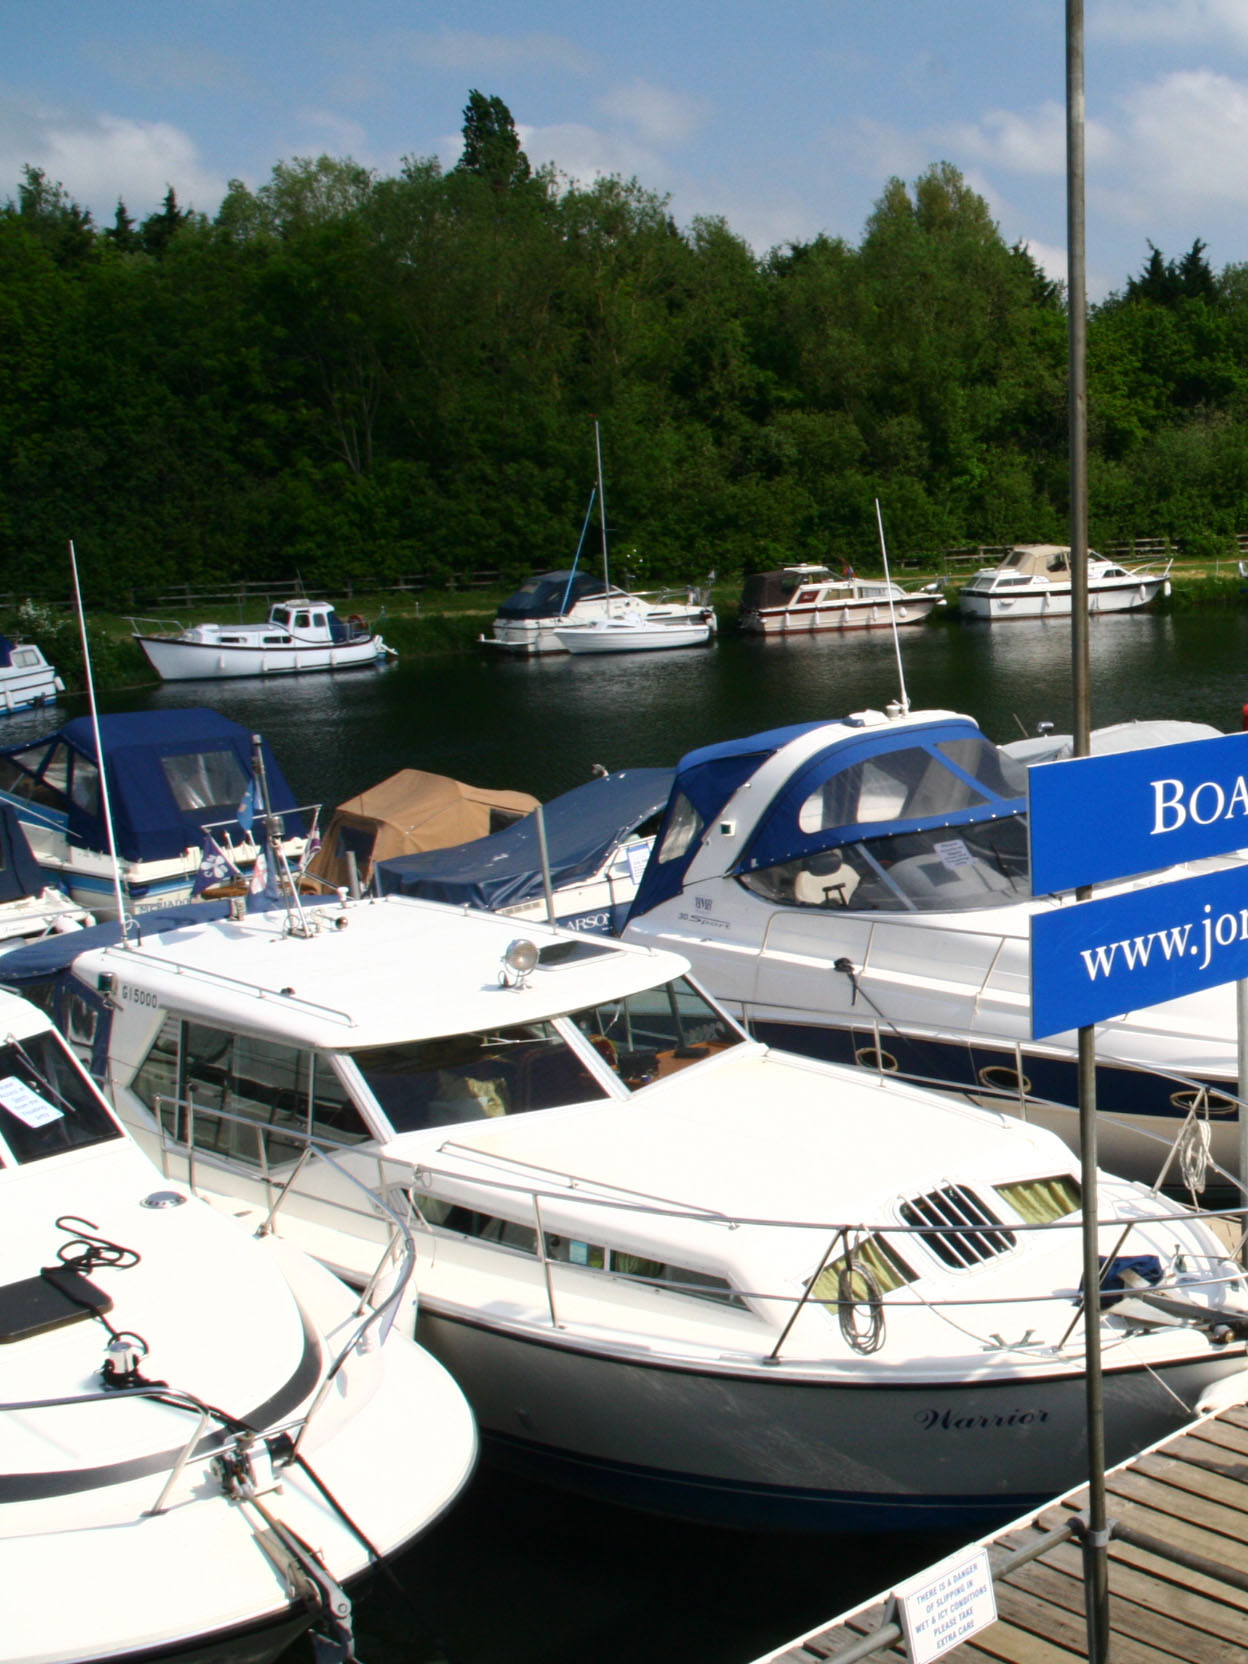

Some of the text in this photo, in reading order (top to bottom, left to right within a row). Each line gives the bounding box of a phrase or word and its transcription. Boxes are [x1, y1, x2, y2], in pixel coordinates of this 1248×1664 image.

[913, 1408, 1049, 1431] Warrior
[916, 1563, 978, 1605] THERE IS A DANGER
[926, 1579, 973, 1613] OF SLIPPING IN
[915, 1620, 930, 1634] WET
[938, 1609, 949, 1621] ICY
[950, 1584, 988, 1613] CONDITIONS
[933, 1606, 974, 1637] PLEASE TAKE
[937, 1620, 975, 1649] EXTRA CARE
